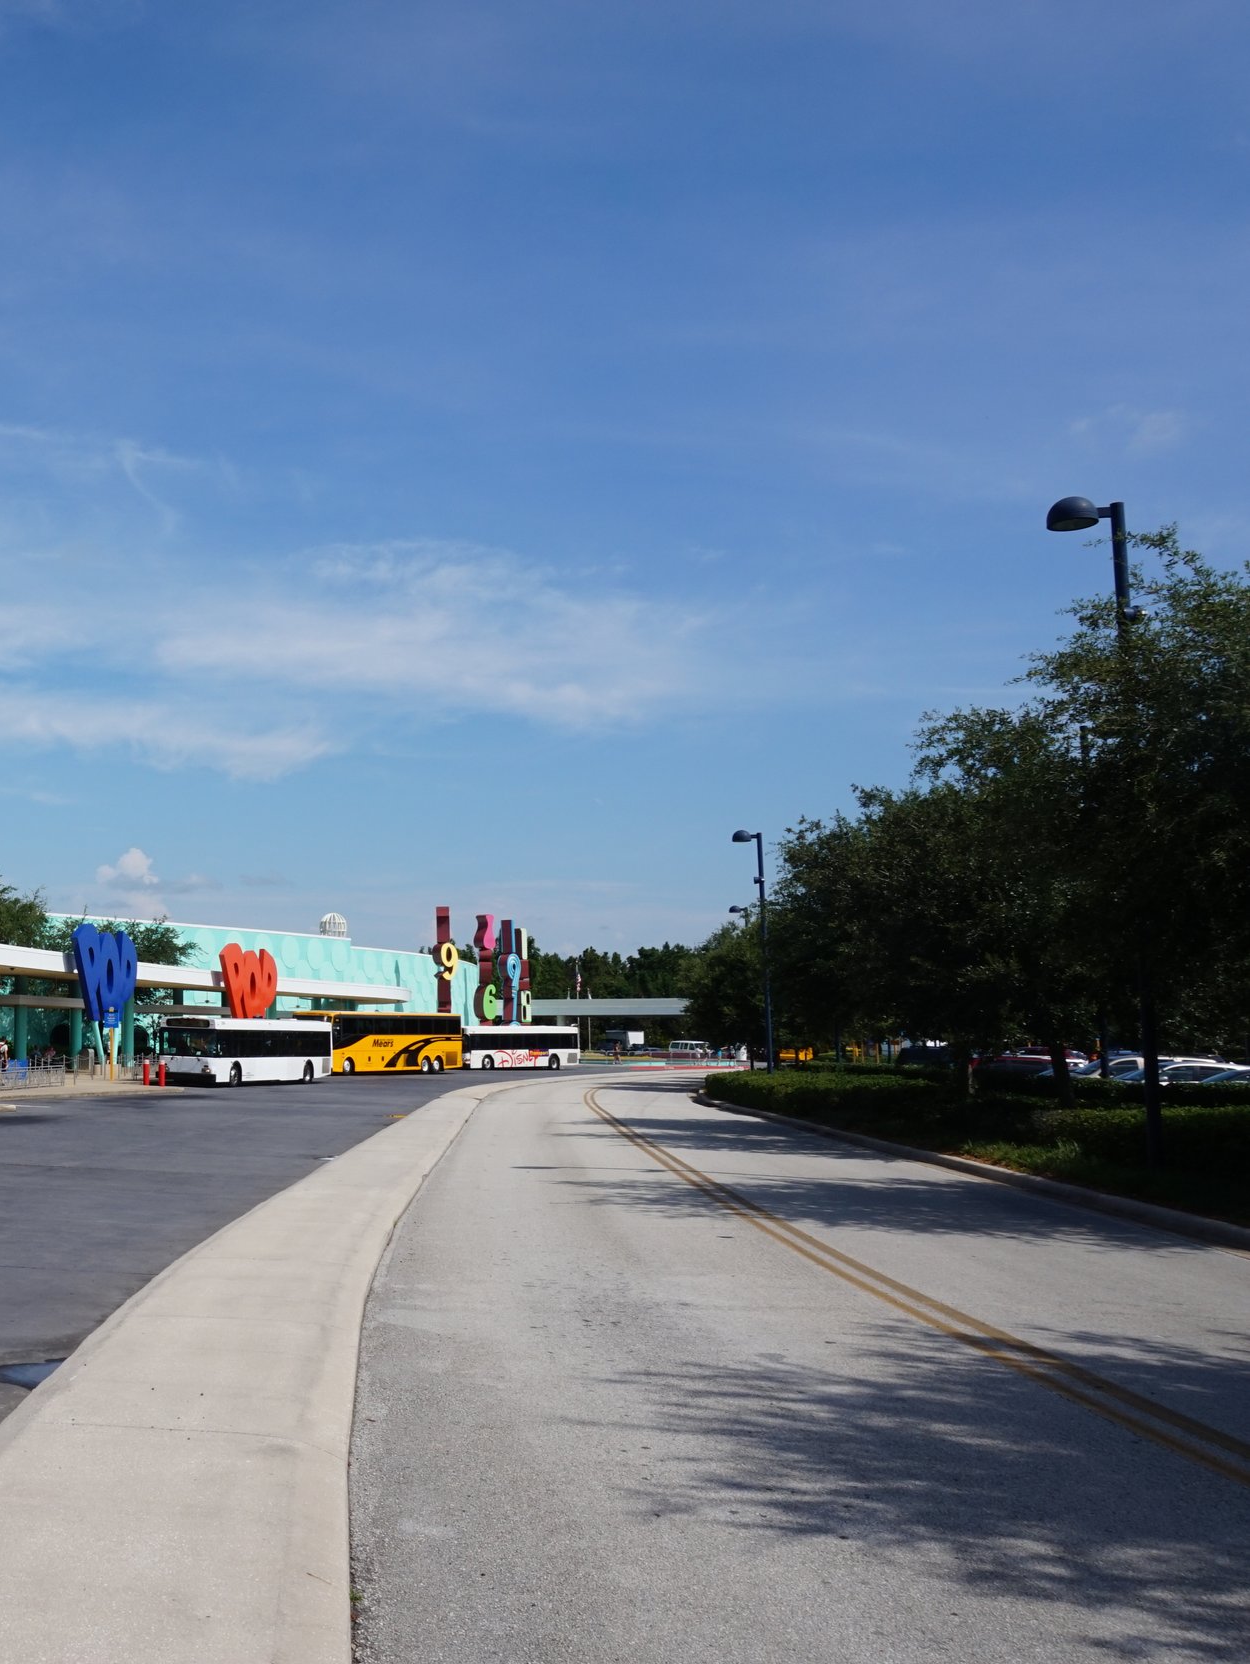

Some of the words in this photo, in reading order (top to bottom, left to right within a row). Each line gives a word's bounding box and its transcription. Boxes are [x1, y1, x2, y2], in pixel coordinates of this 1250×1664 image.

[72, 924, 137, 1021] POP
[219, 943, 277, 1018] POP
[372, 1039, 394, 1048] Mears
